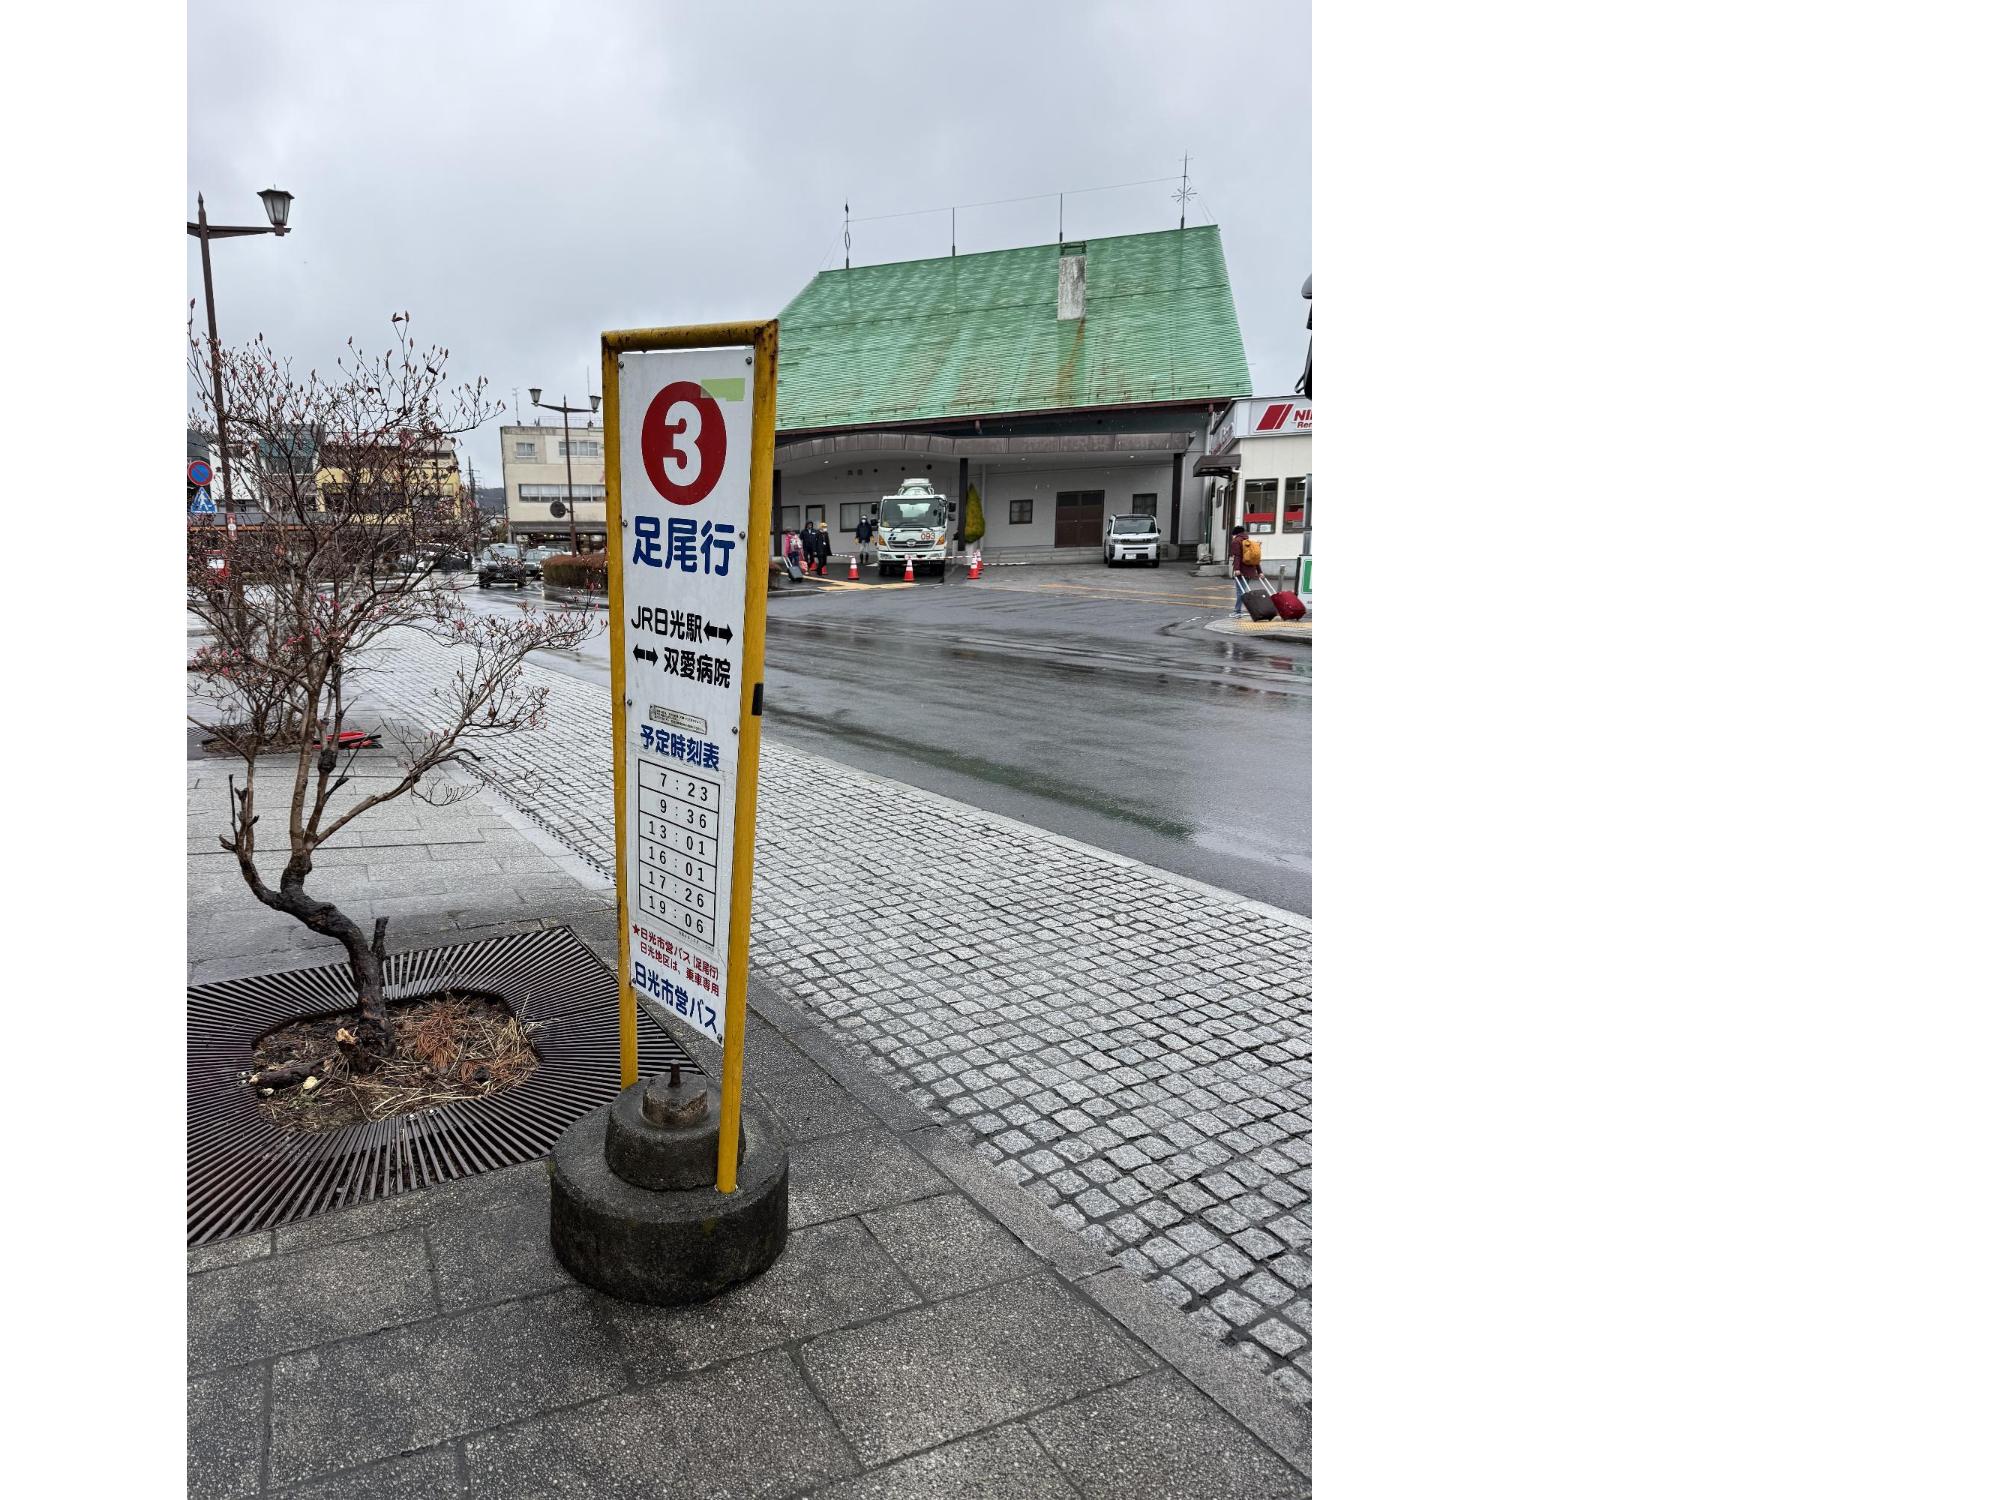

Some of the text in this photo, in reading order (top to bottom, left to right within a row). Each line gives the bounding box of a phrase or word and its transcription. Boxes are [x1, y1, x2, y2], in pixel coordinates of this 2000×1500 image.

[663, 400, 702, 487] 3
[633, 515, 736, 577] 足尾行
[631, 605, 703, 644] JR日光駅
[664, 647, 731, 689] 双愛病院
[640, 724, 720, 771] 予定時刻表
[635, 961, 717, 1034] 日光市営バス
